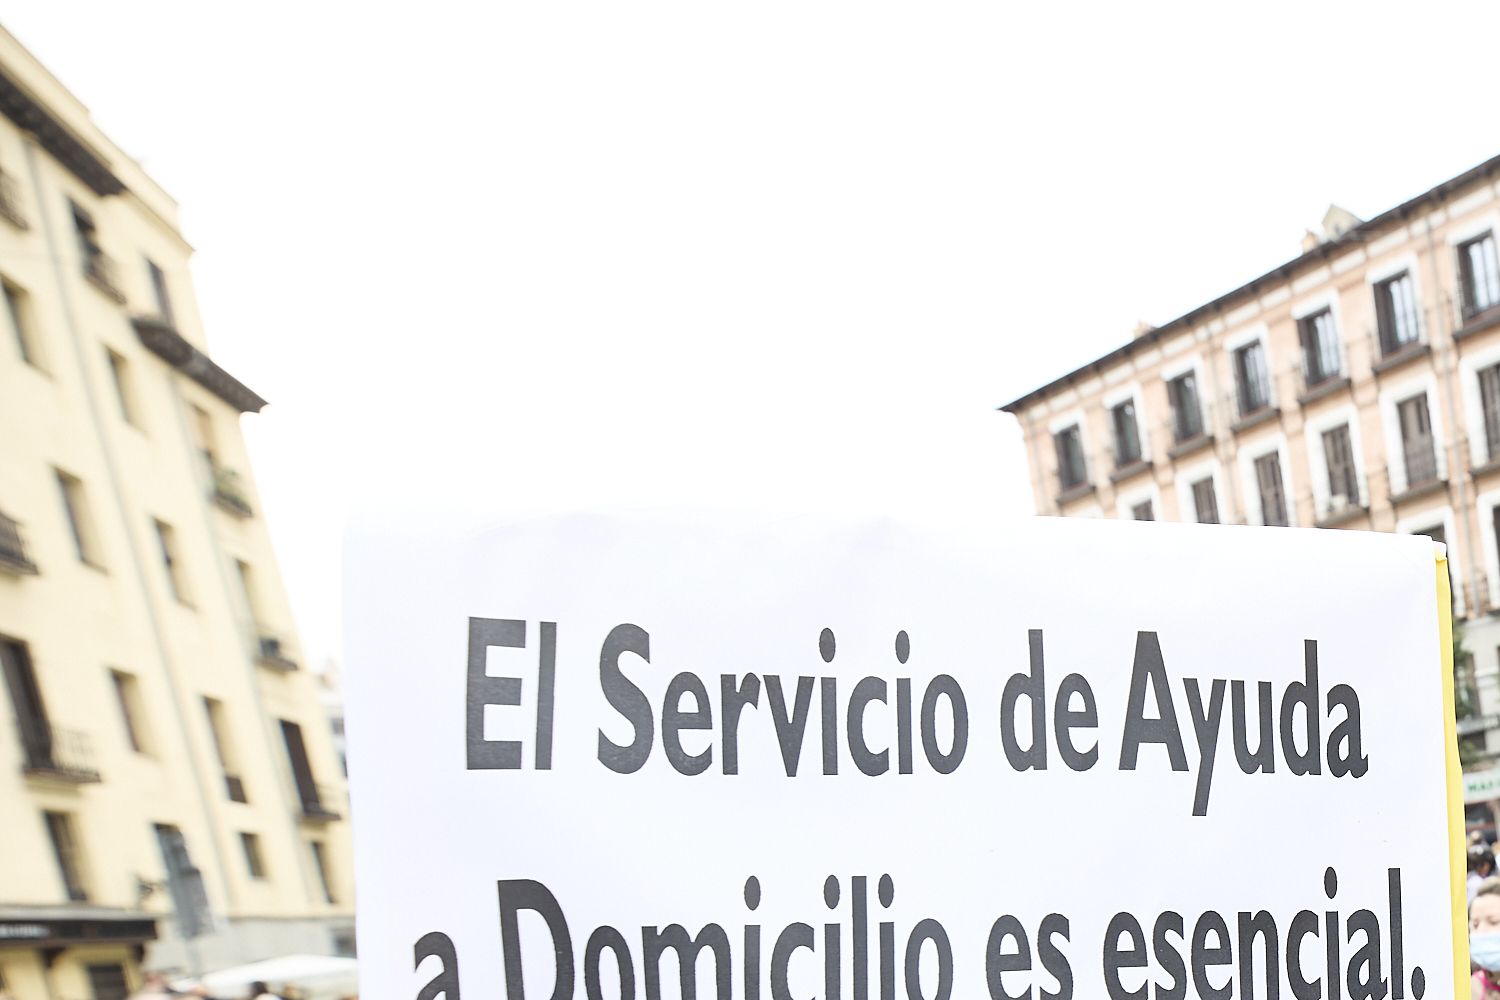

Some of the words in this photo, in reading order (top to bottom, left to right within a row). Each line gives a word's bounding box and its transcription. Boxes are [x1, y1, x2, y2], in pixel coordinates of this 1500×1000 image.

[467, 617, 556, 770] El
[598, 624, 968, 777] Servicio
[1001, 629, 1098, 772] de
[1119, 631, 1368, 816] Ayuda
